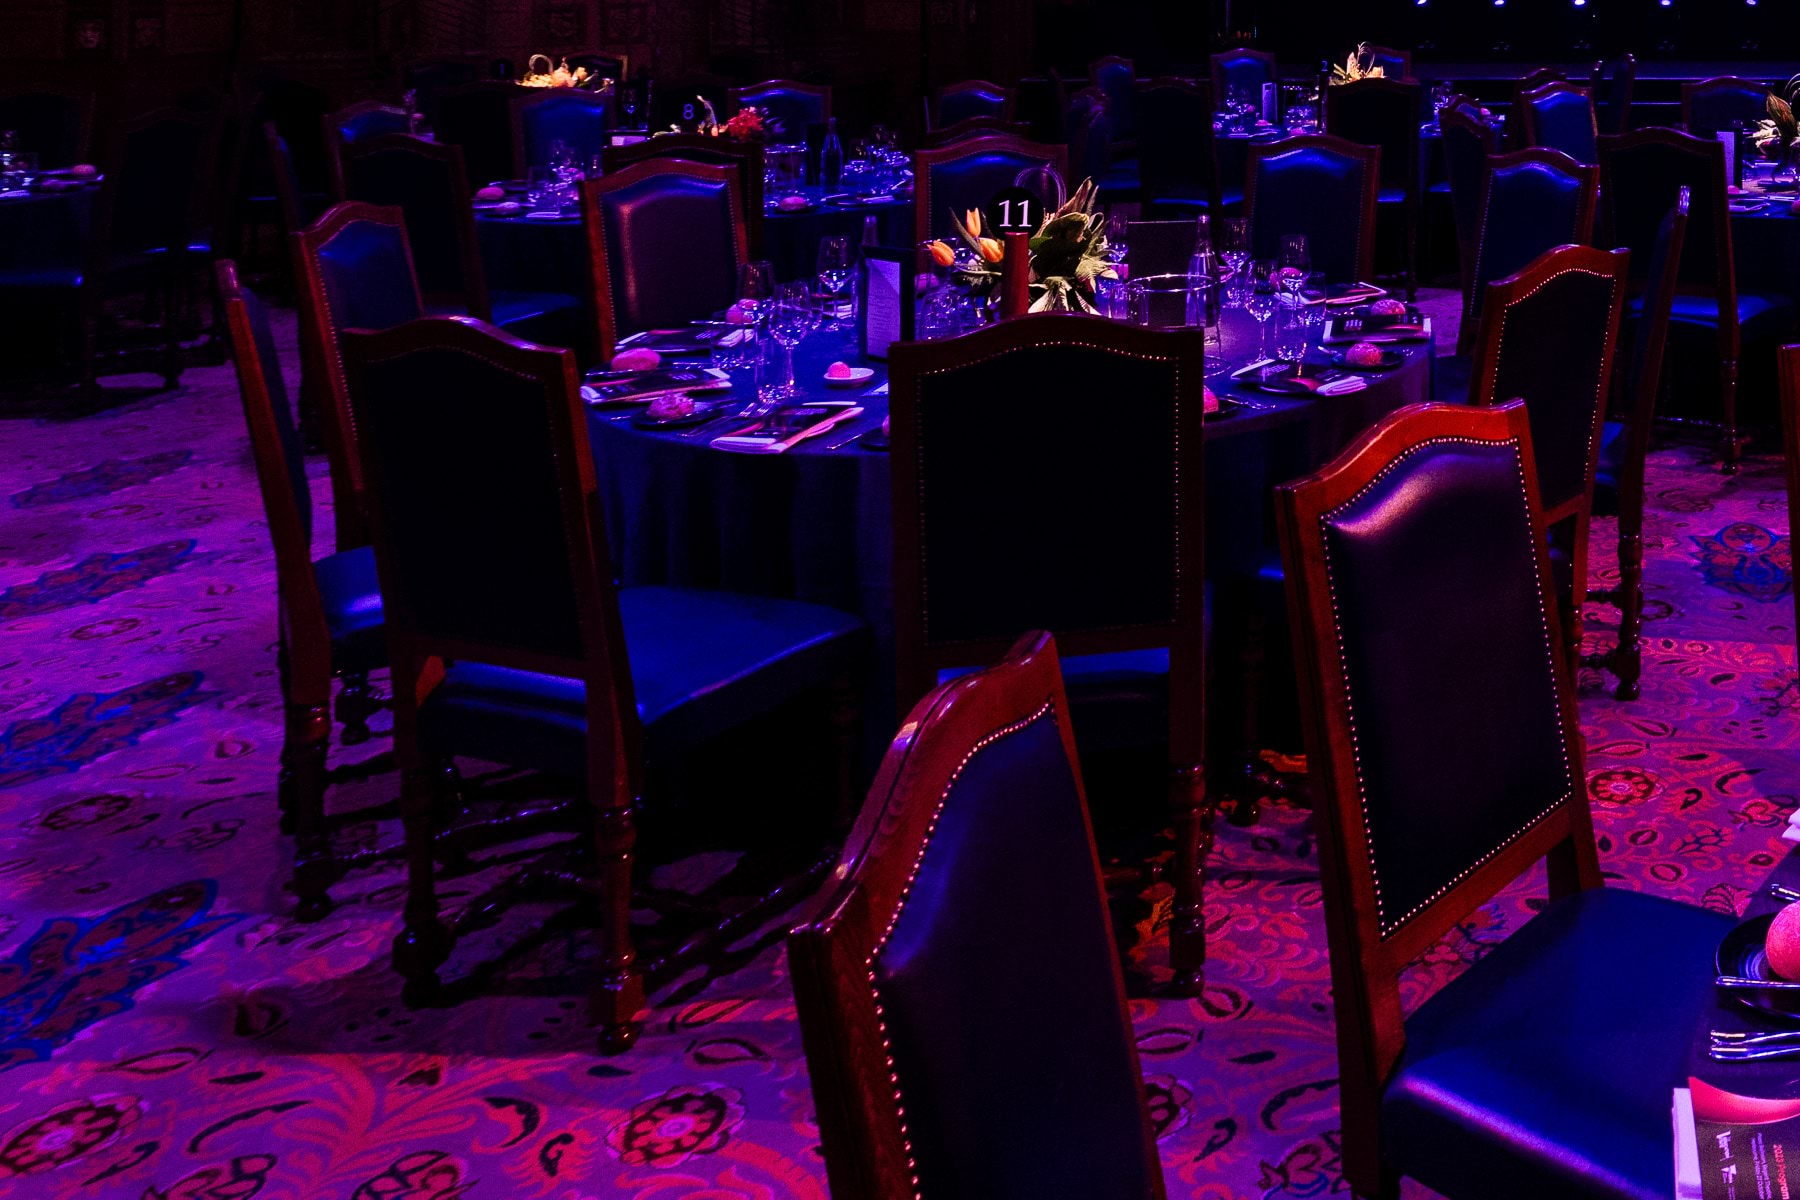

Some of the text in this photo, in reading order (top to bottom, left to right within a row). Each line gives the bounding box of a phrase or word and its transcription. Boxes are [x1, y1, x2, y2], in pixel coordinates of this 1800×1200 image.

[1321, 60, 1328, 72] 2
[681, 103, 696, 120] 8
[998, 200, 1032, 228] 11
[1776, 1164, 1790, 1200] Program
